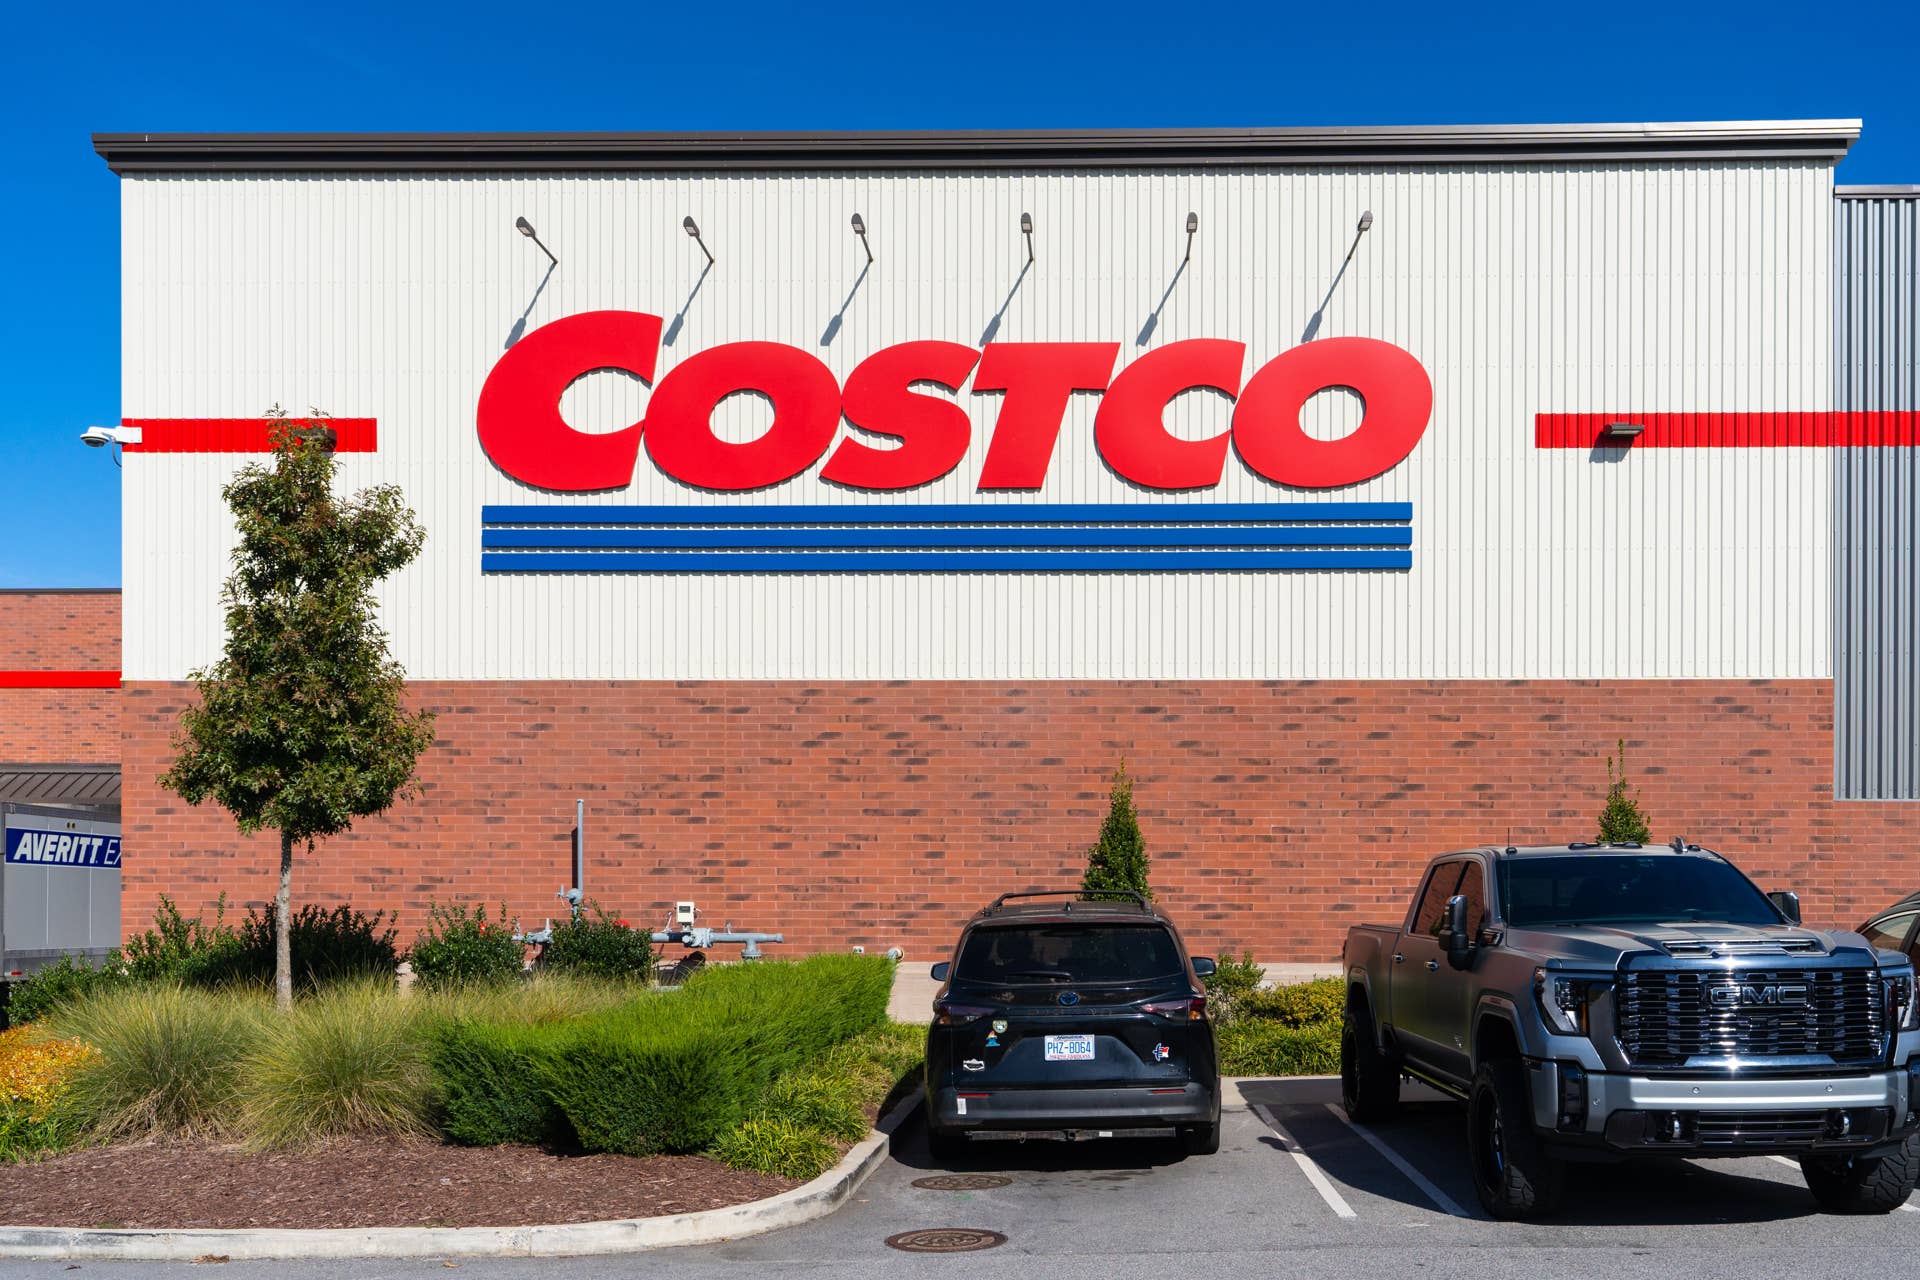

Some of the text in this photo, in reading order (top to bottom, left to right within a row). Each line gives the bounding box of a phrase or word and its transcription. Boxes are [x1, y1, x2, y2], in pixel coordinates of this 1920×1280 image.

[477, 310, 1432, 492] COSTCO
[13, 832, 103, 864] AVERITT
[1710, 986, 1807, 1004] GMC
